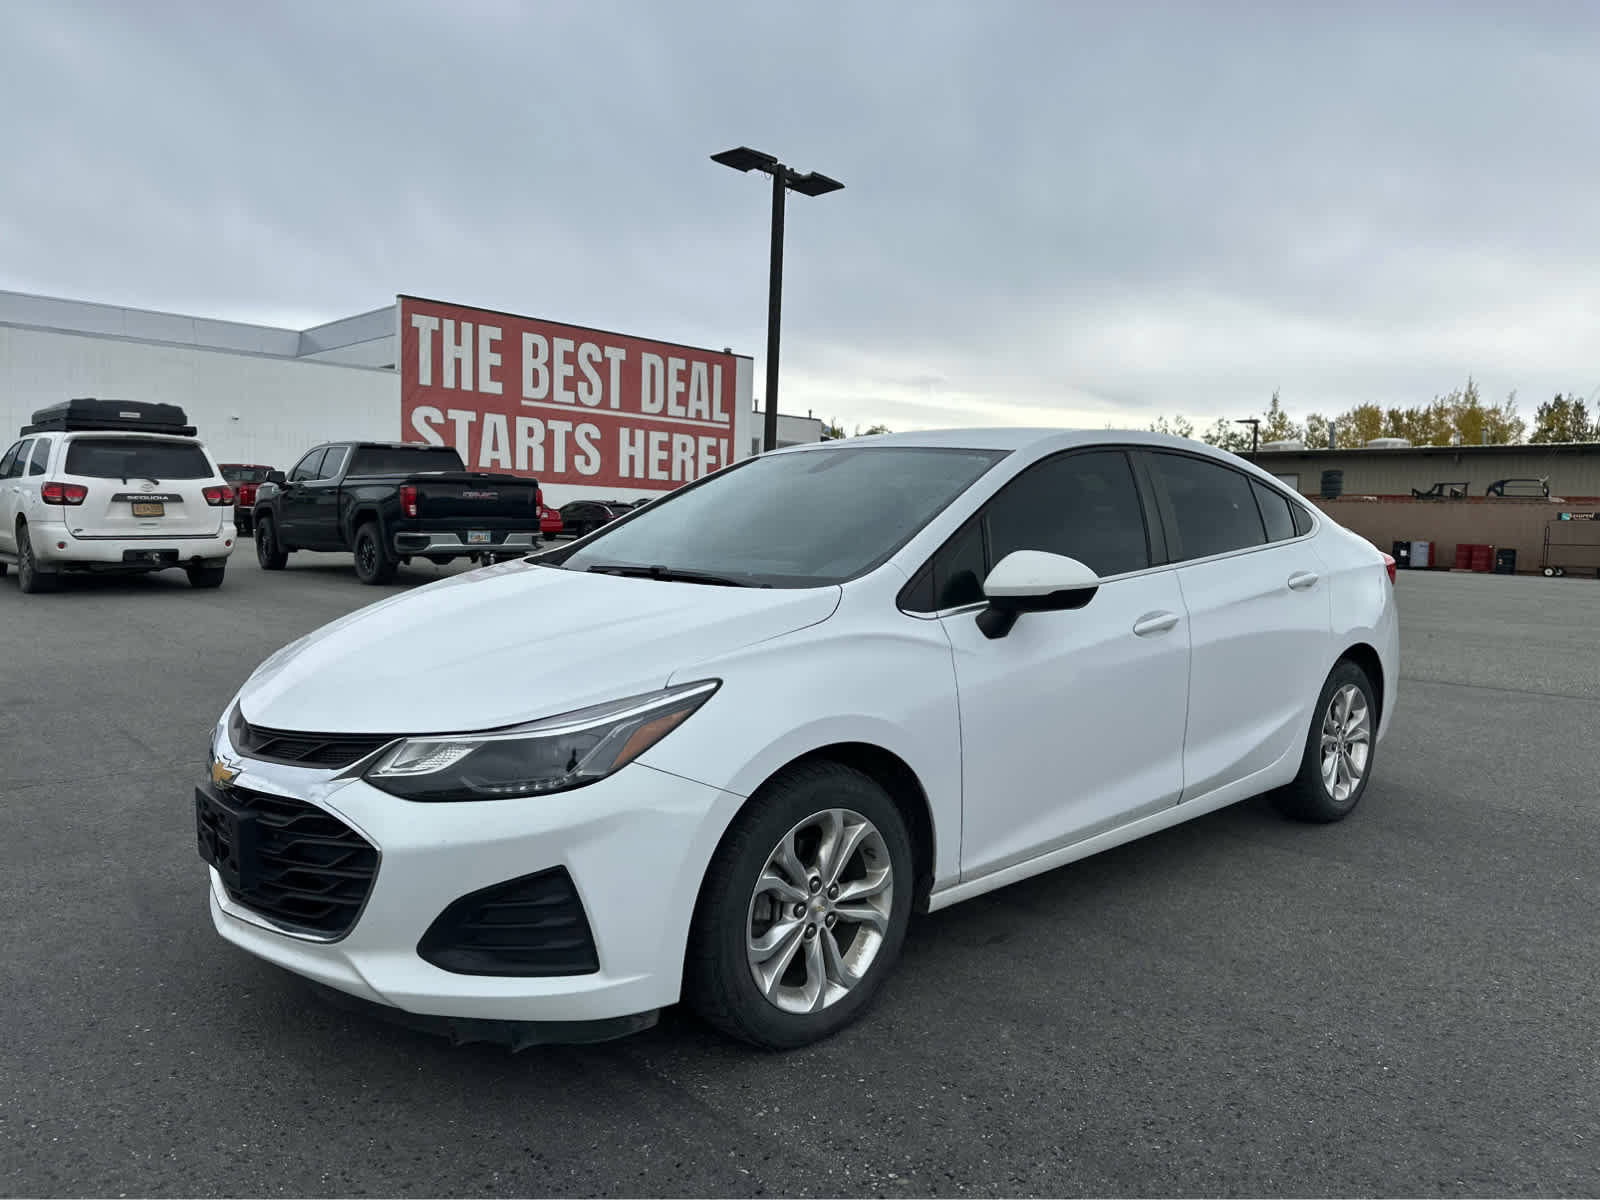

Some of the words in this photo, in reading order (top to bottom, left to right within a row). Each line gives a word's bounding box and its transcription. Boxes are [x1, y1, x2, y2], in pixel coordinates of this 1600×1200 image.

[411, 313, 503, 395] THE
[522, 331, 627, 409] BEST
[641, 352, 730, 422] DEAL
[411, 405, 602, 475] STARTS
[618, 426, 729, 482] HERE!
